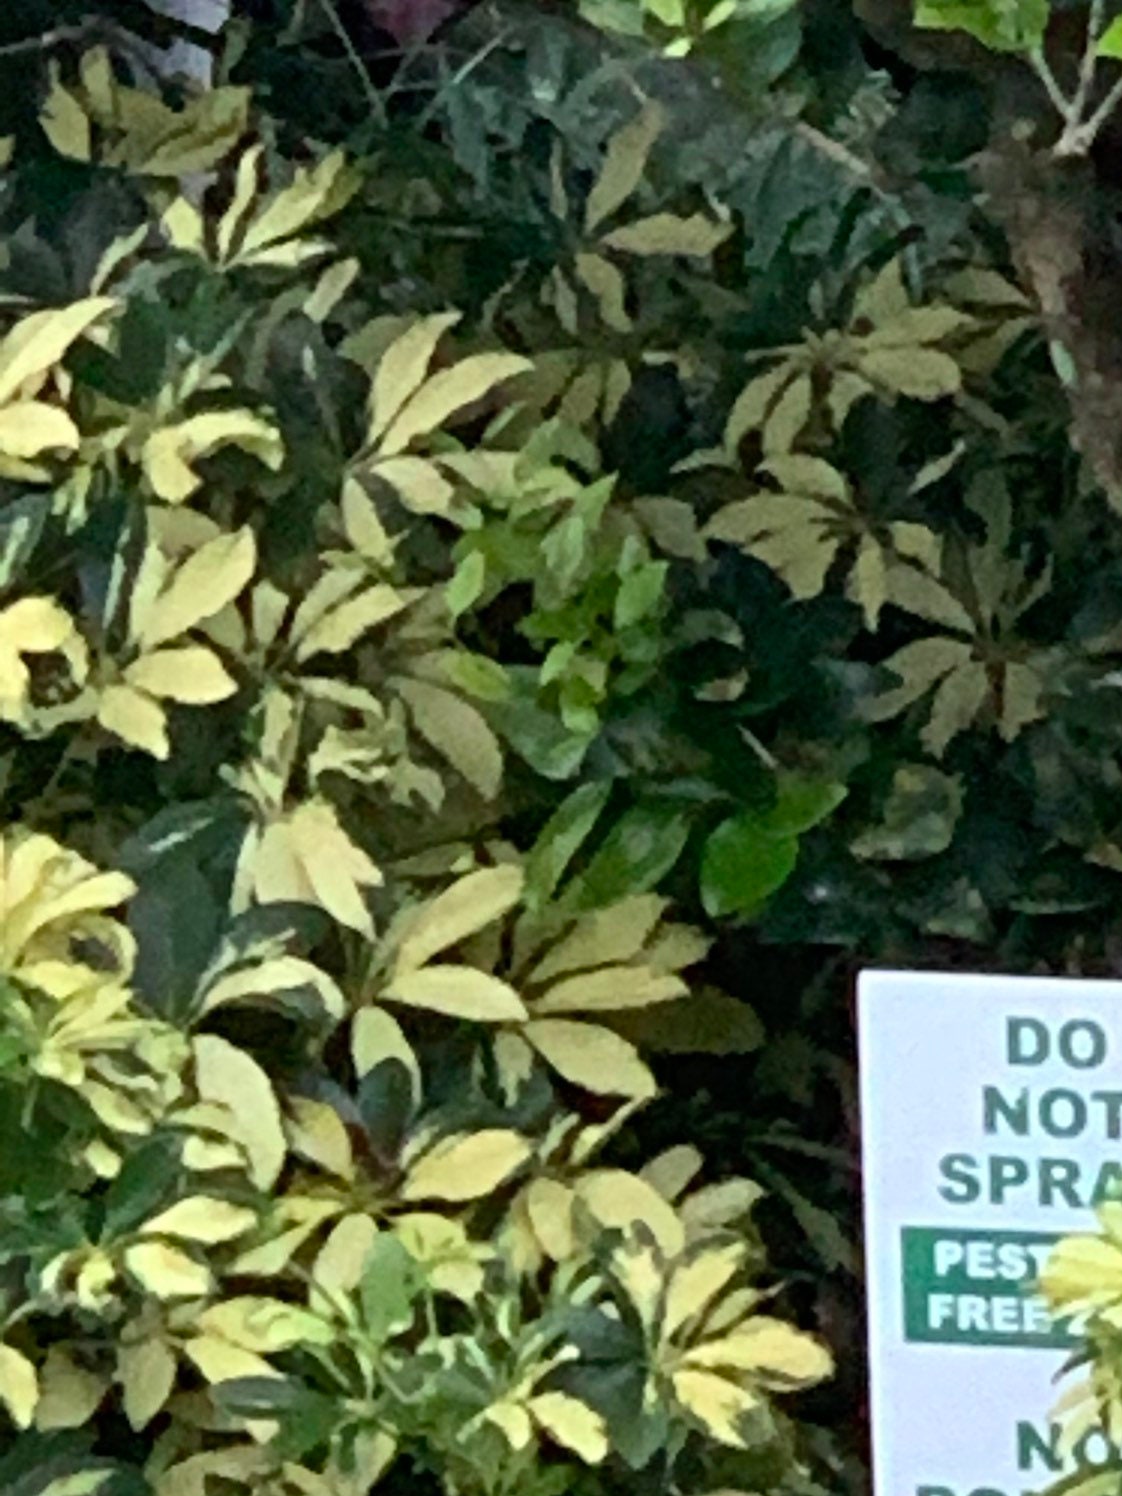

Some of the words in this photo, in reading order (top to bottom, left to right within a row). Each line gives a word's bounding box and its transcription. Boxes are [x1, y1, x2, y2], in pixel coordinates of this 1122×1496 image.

[1006, 1016, 1108, 1068] DO
[927, 1293, 1053, 1333] FREE
[1017, 1420, 1122, 1471] NO
